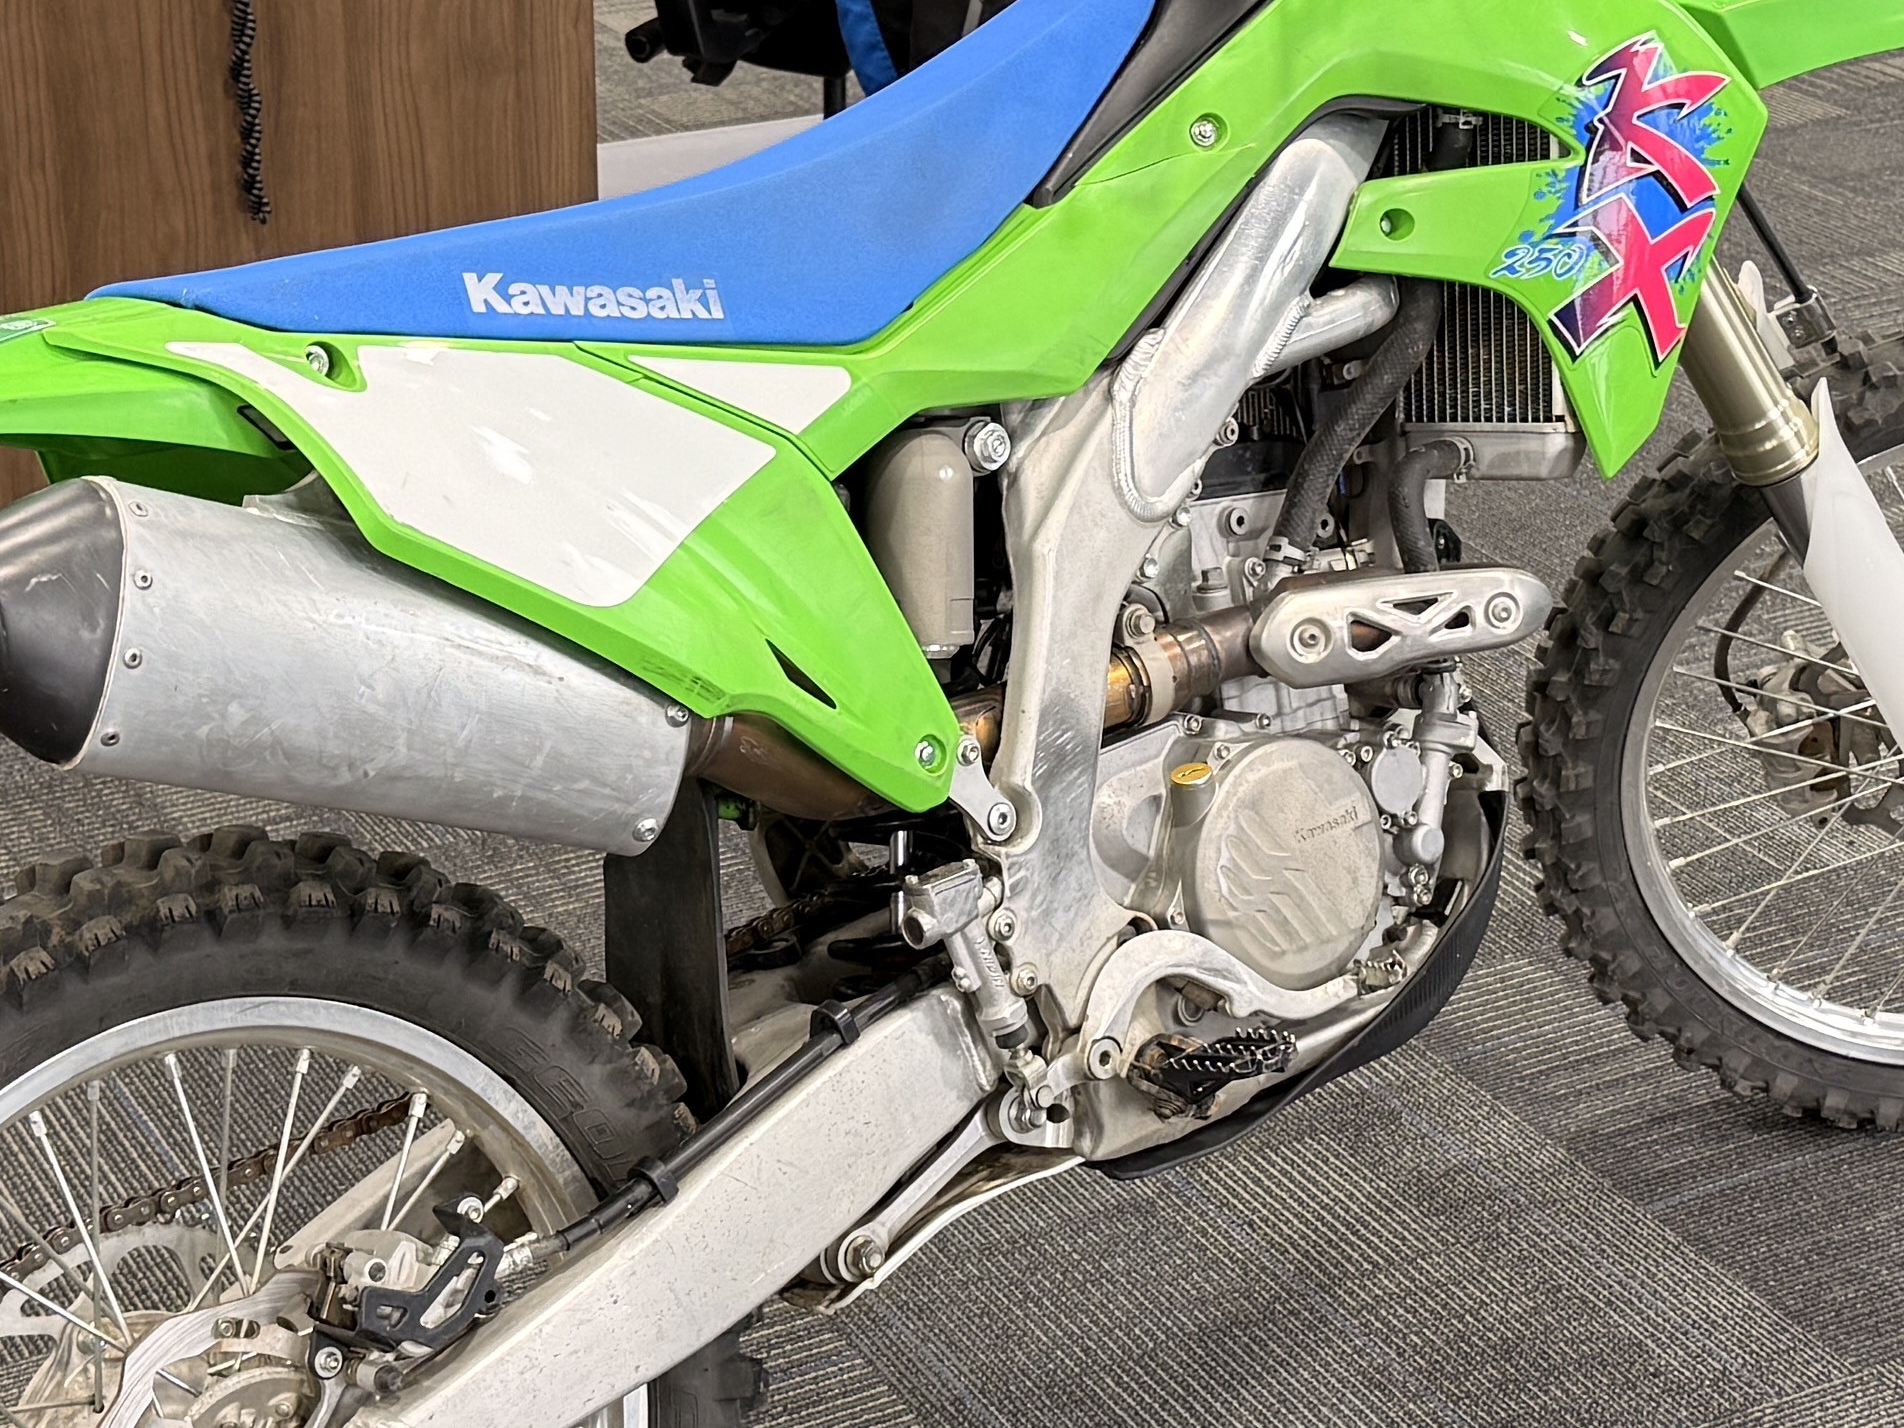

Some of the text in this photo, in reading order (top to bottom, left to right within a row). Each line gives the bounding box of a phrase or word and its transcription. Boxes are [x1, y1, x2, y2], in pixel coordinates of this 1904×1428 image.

[1489, 244, 1588, 281] 250
[462, 272, 725, 320] Kawasaki
[1294, 804, 1359, 844] Kawasaki
